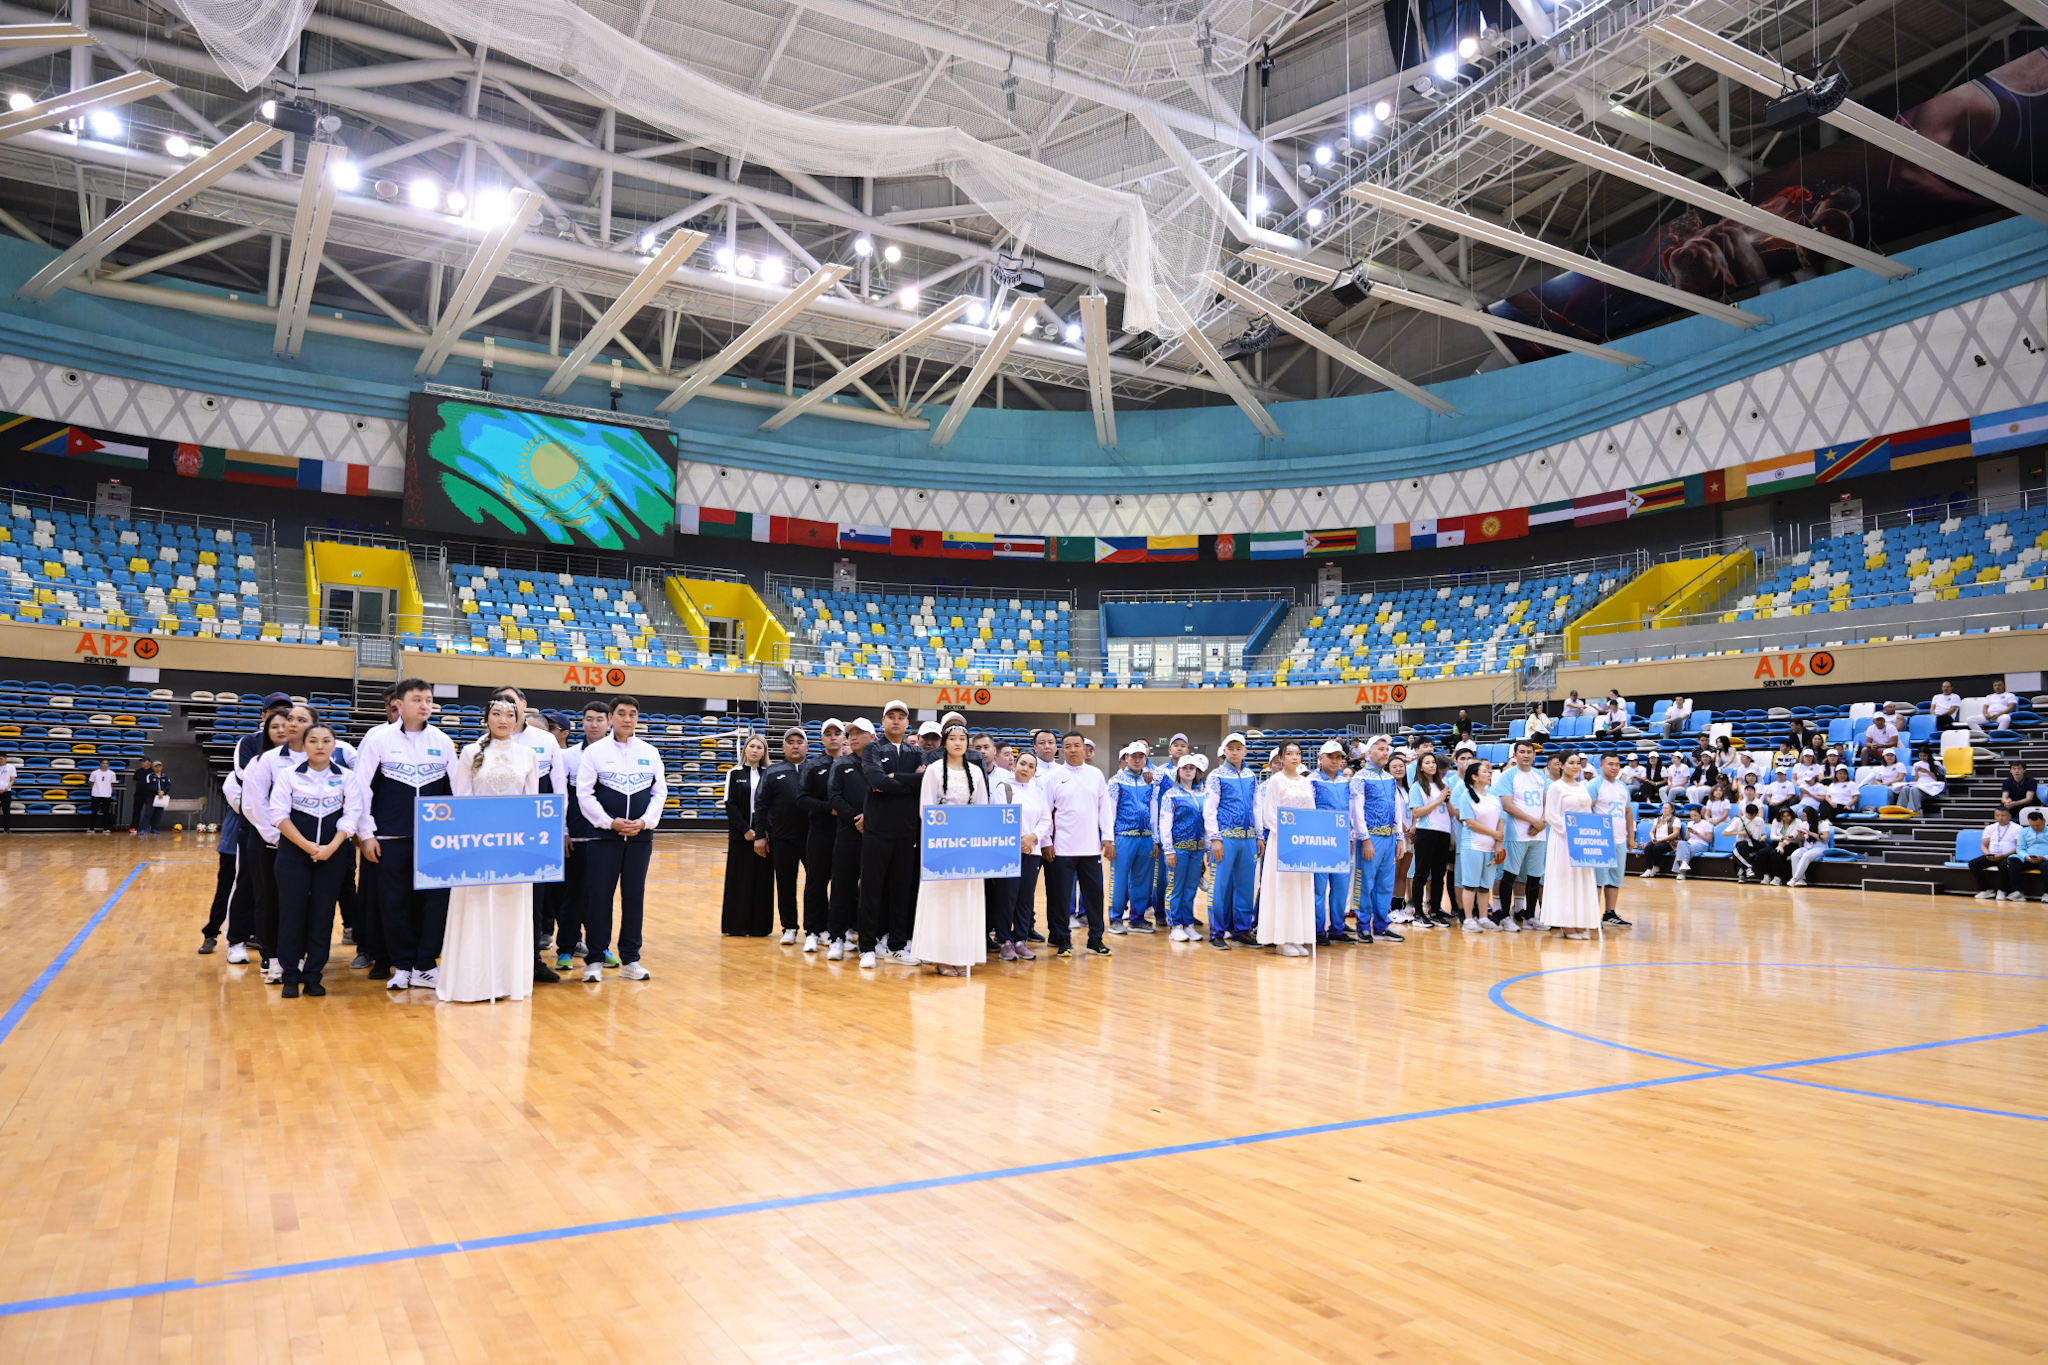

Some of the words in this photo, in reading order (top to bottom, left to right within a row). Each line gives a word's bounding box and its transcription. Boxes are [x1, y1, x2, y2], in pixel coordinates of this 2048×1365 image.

[75, 632, 128, 658] A12
[83, 656, 118, 665] SEKTOR
[1754, 653, 1805, 679] A16
[563, 665, 603, 686] A13
[937, 687, 972, 704] A14
[1355, 685, 1389, 704] A15
[1523, 790, 1542, 807] 83
[422, 803, 451, 822] 30
[535, 800, 554, 818] 15
[1001, 808, 1015, 824] 15
[1608, 801, 1624, 818] 25
[926, 810, 947, 826] 30
[1280, 811, 1295, 825] 30
[1335, 814, 1346, 828] 15
[1566, 815, 1577, 827] 30
[539, 831, 549, 845] 2
[928, 836, 1016, 849] БАТЫС-ШЫҒЫС
[1291, 834, 1338, 848] ОРТАЛЫҚ
[1207, 862, 1218, 907] KAZAKHSTAN
[1353, 868, 1363, 910] KAZAKHSTAN
